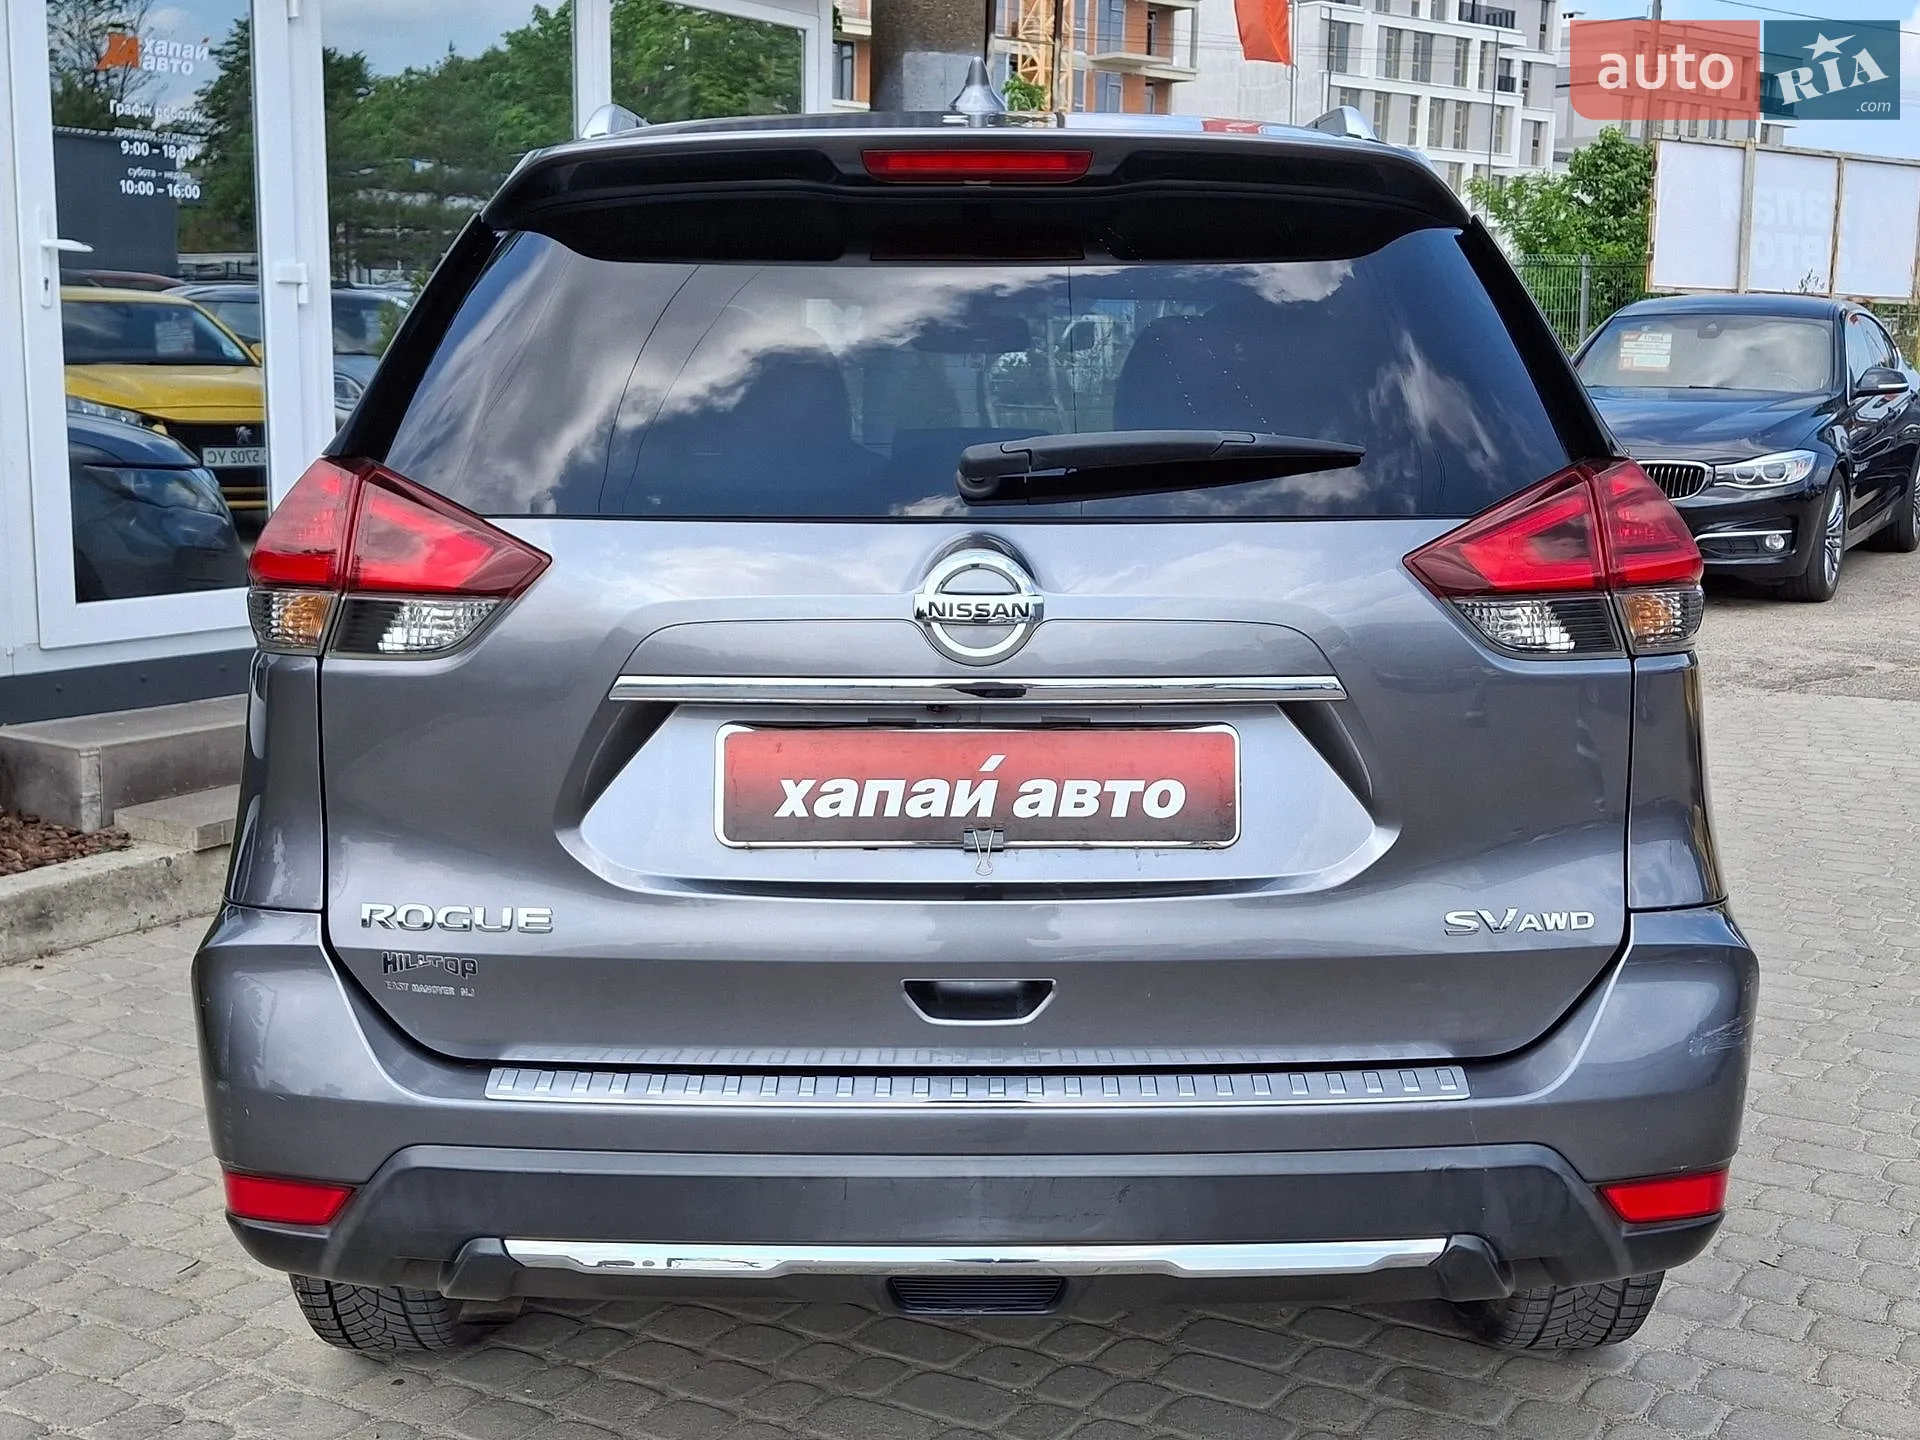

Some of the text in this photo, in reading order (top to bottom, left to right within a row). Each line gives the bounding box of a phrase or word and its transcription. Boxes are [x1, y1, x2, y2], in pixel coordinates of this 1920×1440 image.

[142, 54, 194, 76] авто
[109, 99, 199, 123] Графік роботи
[120, 140, 150, 156] 9:00
[161, 144, 197, 161] 18:00
[119, 179, 154, 196] 10:00
[167, 183, 201, 200] 16:00
[928, 601, 1029, 618] NISSAN
[1012, 778, 1187, 818] авто
[361, 902, 554, 934] ROGUE
[1444, 907, 1595, 936] SV AWD
[382, 951, 478, 980] HILLTOP
[384, 981, 409, 992] EAST
